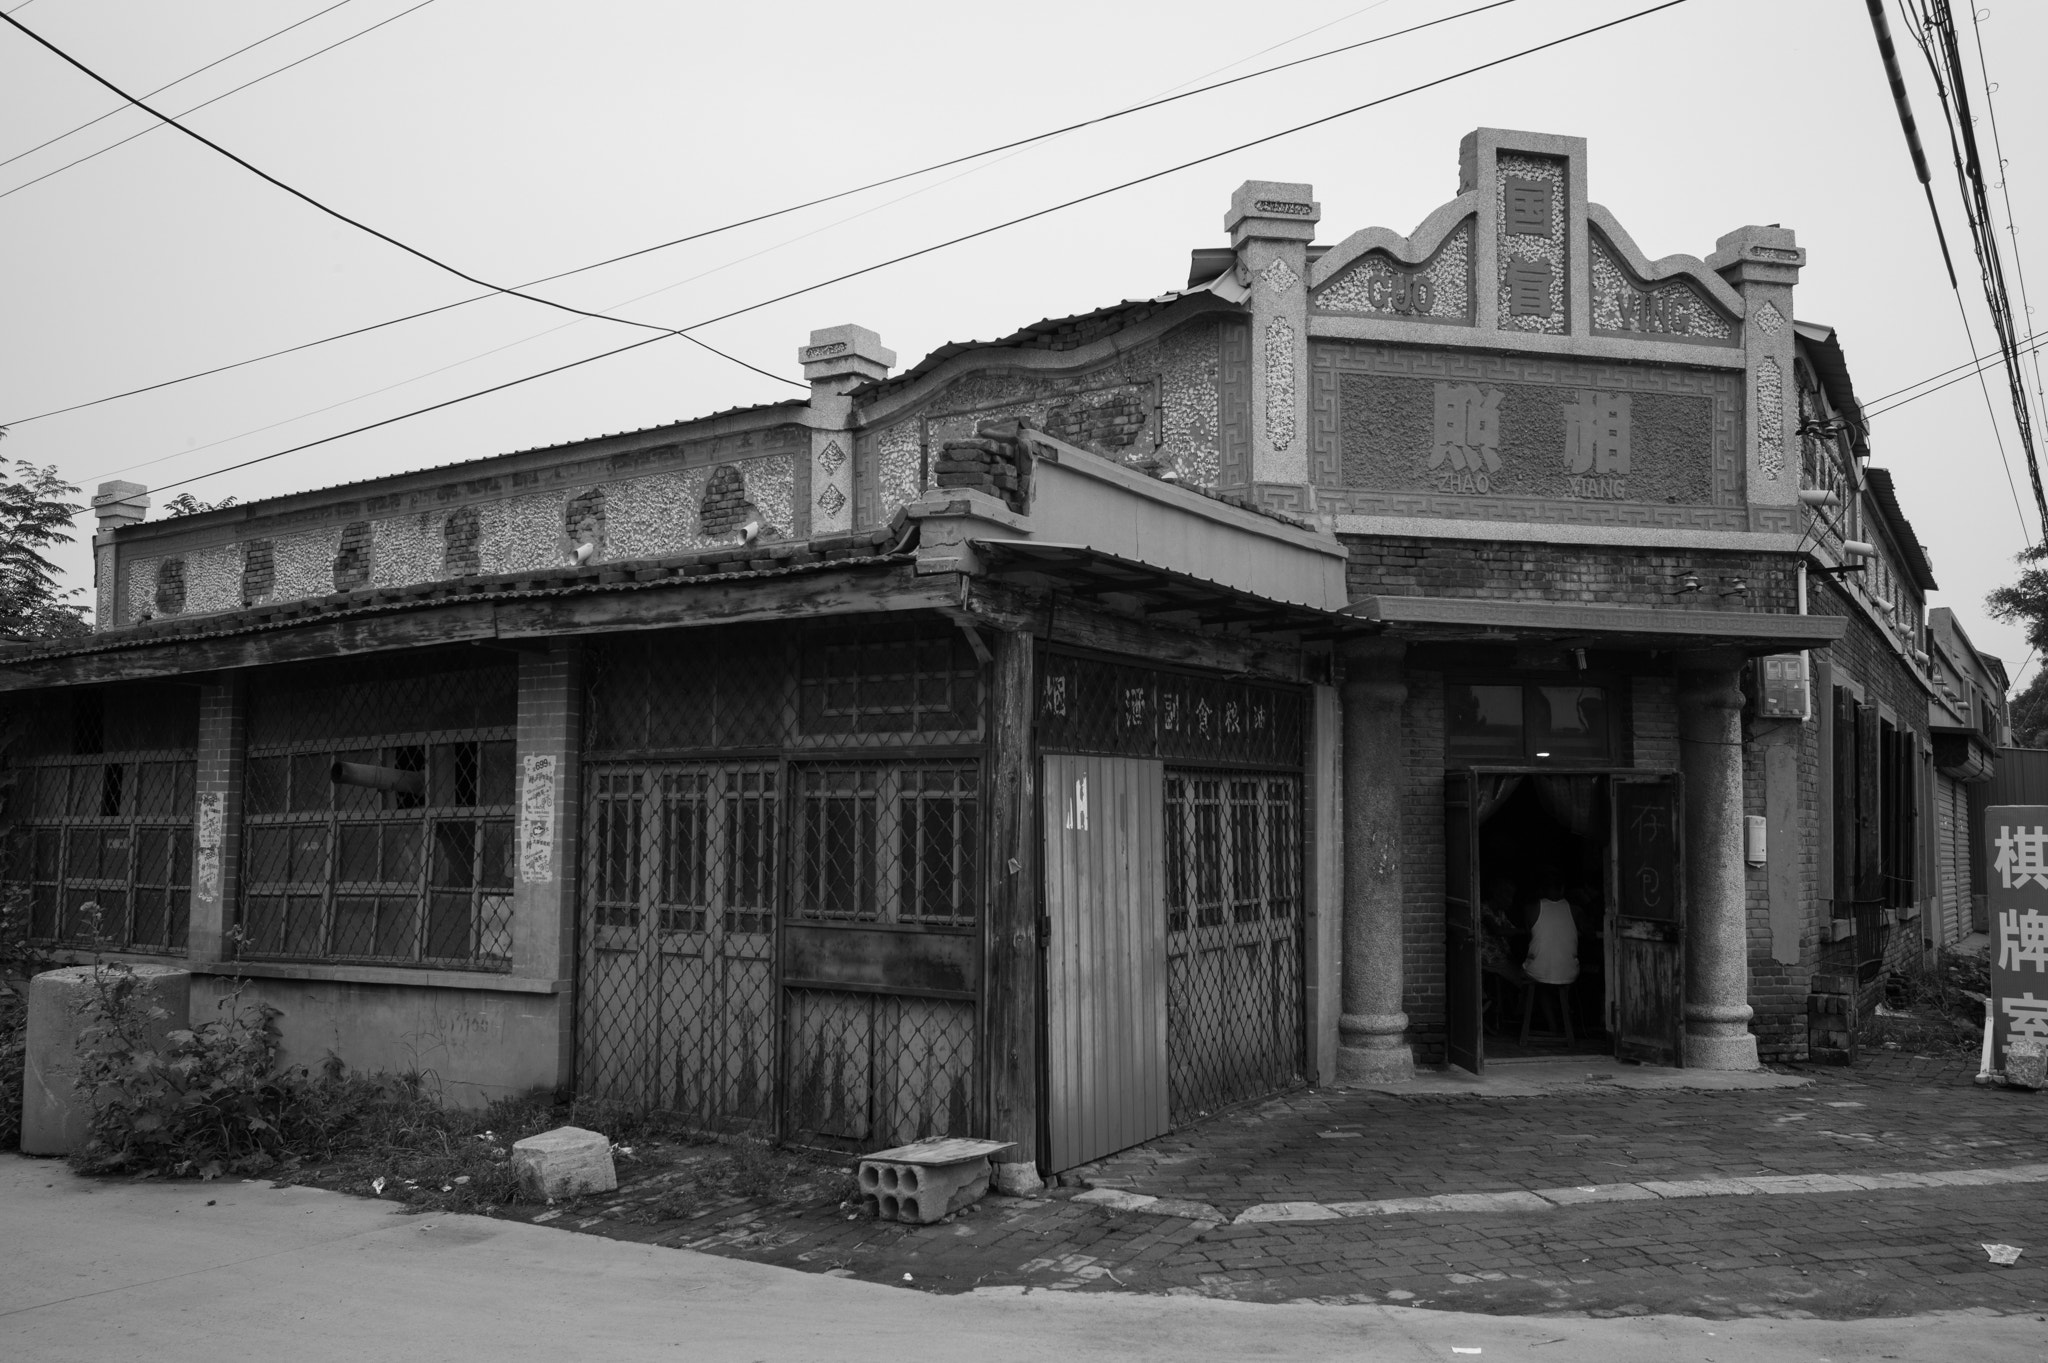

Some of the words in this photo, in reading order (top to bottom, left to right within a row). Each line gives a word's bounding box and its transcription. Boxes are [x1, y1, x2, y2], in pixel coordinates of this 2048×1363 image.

[1505, 177, 1554, 318] 国营
[1367, 272, 1434, 313] GUO
[1616, 293, 1691, 334] YING
[1427, 382, 1632, 475] 照相
[1437, 473, 1490, 495] ZHAO
[1567, 477, 1626, 499] XIANG
[1630, 802, 1666, 908] 存包
